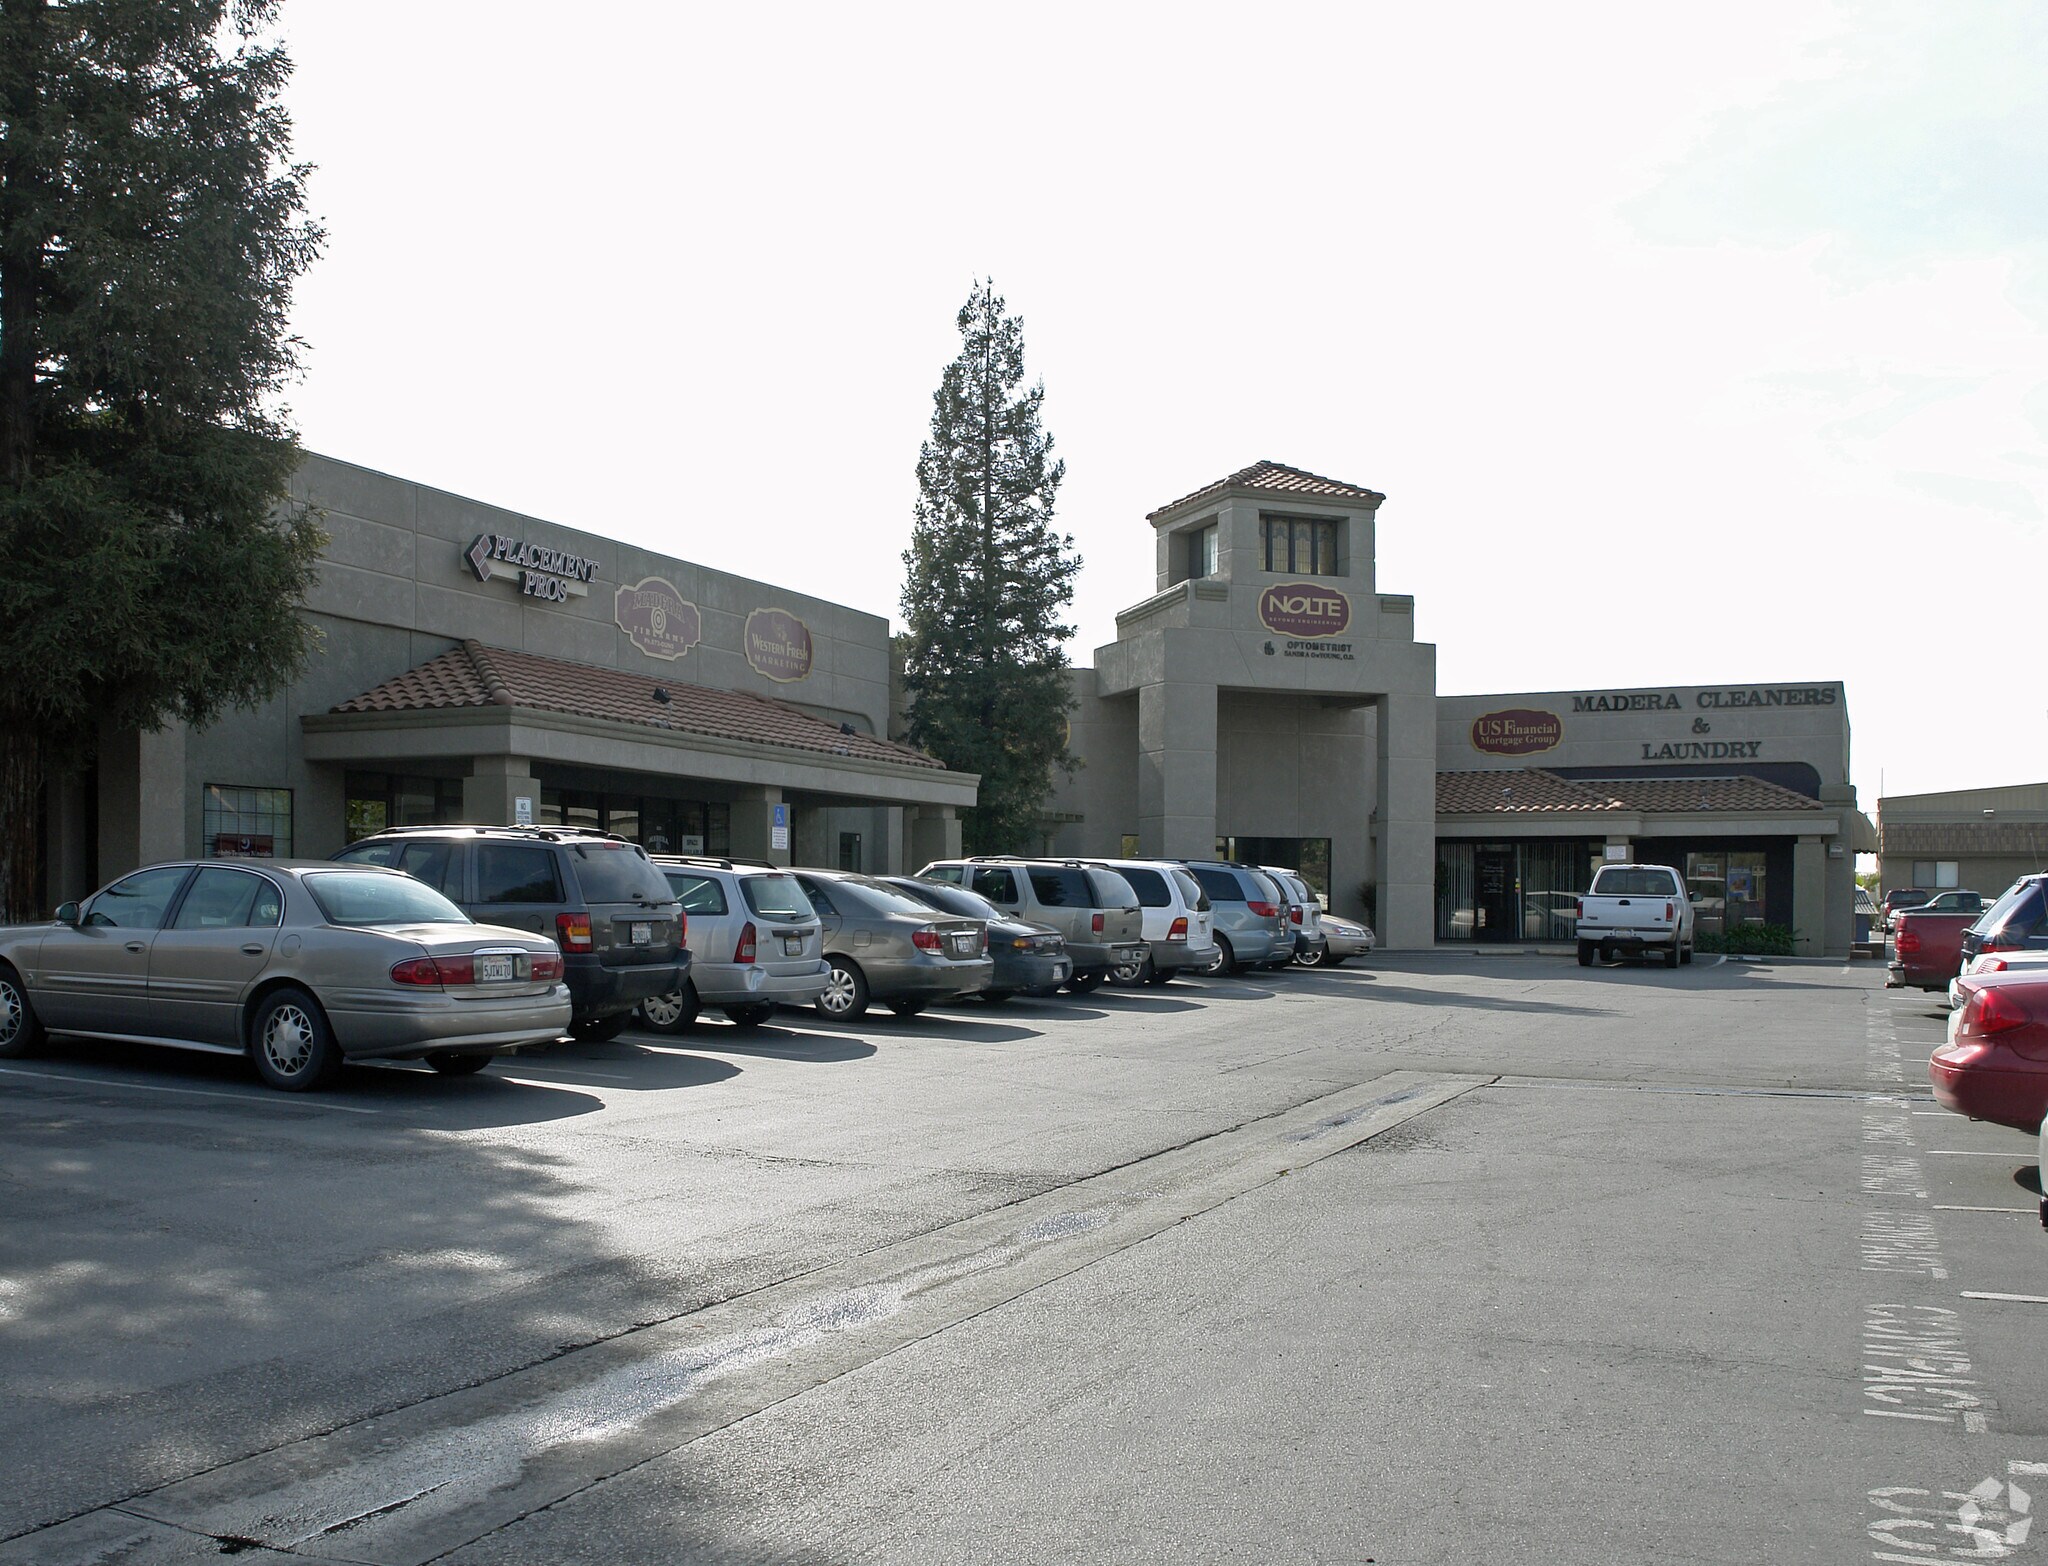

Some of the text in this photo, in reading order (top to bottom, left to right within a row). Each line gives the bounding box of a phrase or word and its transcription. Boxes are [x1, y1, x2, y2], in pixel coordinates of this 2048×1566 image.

[492, 534, 600, 583] PLACEMENT
[523, 571, 568, 603] PROS
[1269, 594, 1341, 617] NOLTE
[633, 625, 684, 643] FIREARMS
[1287, 641, 1352, 653] OPTOMETRIST
[754, 654, 805, 671] MARKETING
[1572, 687, 1836, 713] MADERA CLEANERS
[1478, 719, 1557, 736] US Financial
[1691, 717, 1711, 735] &
[1480, 735, 1555, 746] Mortgage Group
[1641, 741, 1762, 761] LAUNDRY
[1860, 1211, 1949, 1279] COMPACT
[1862, 1303, 1988, 1434] COMPACT
